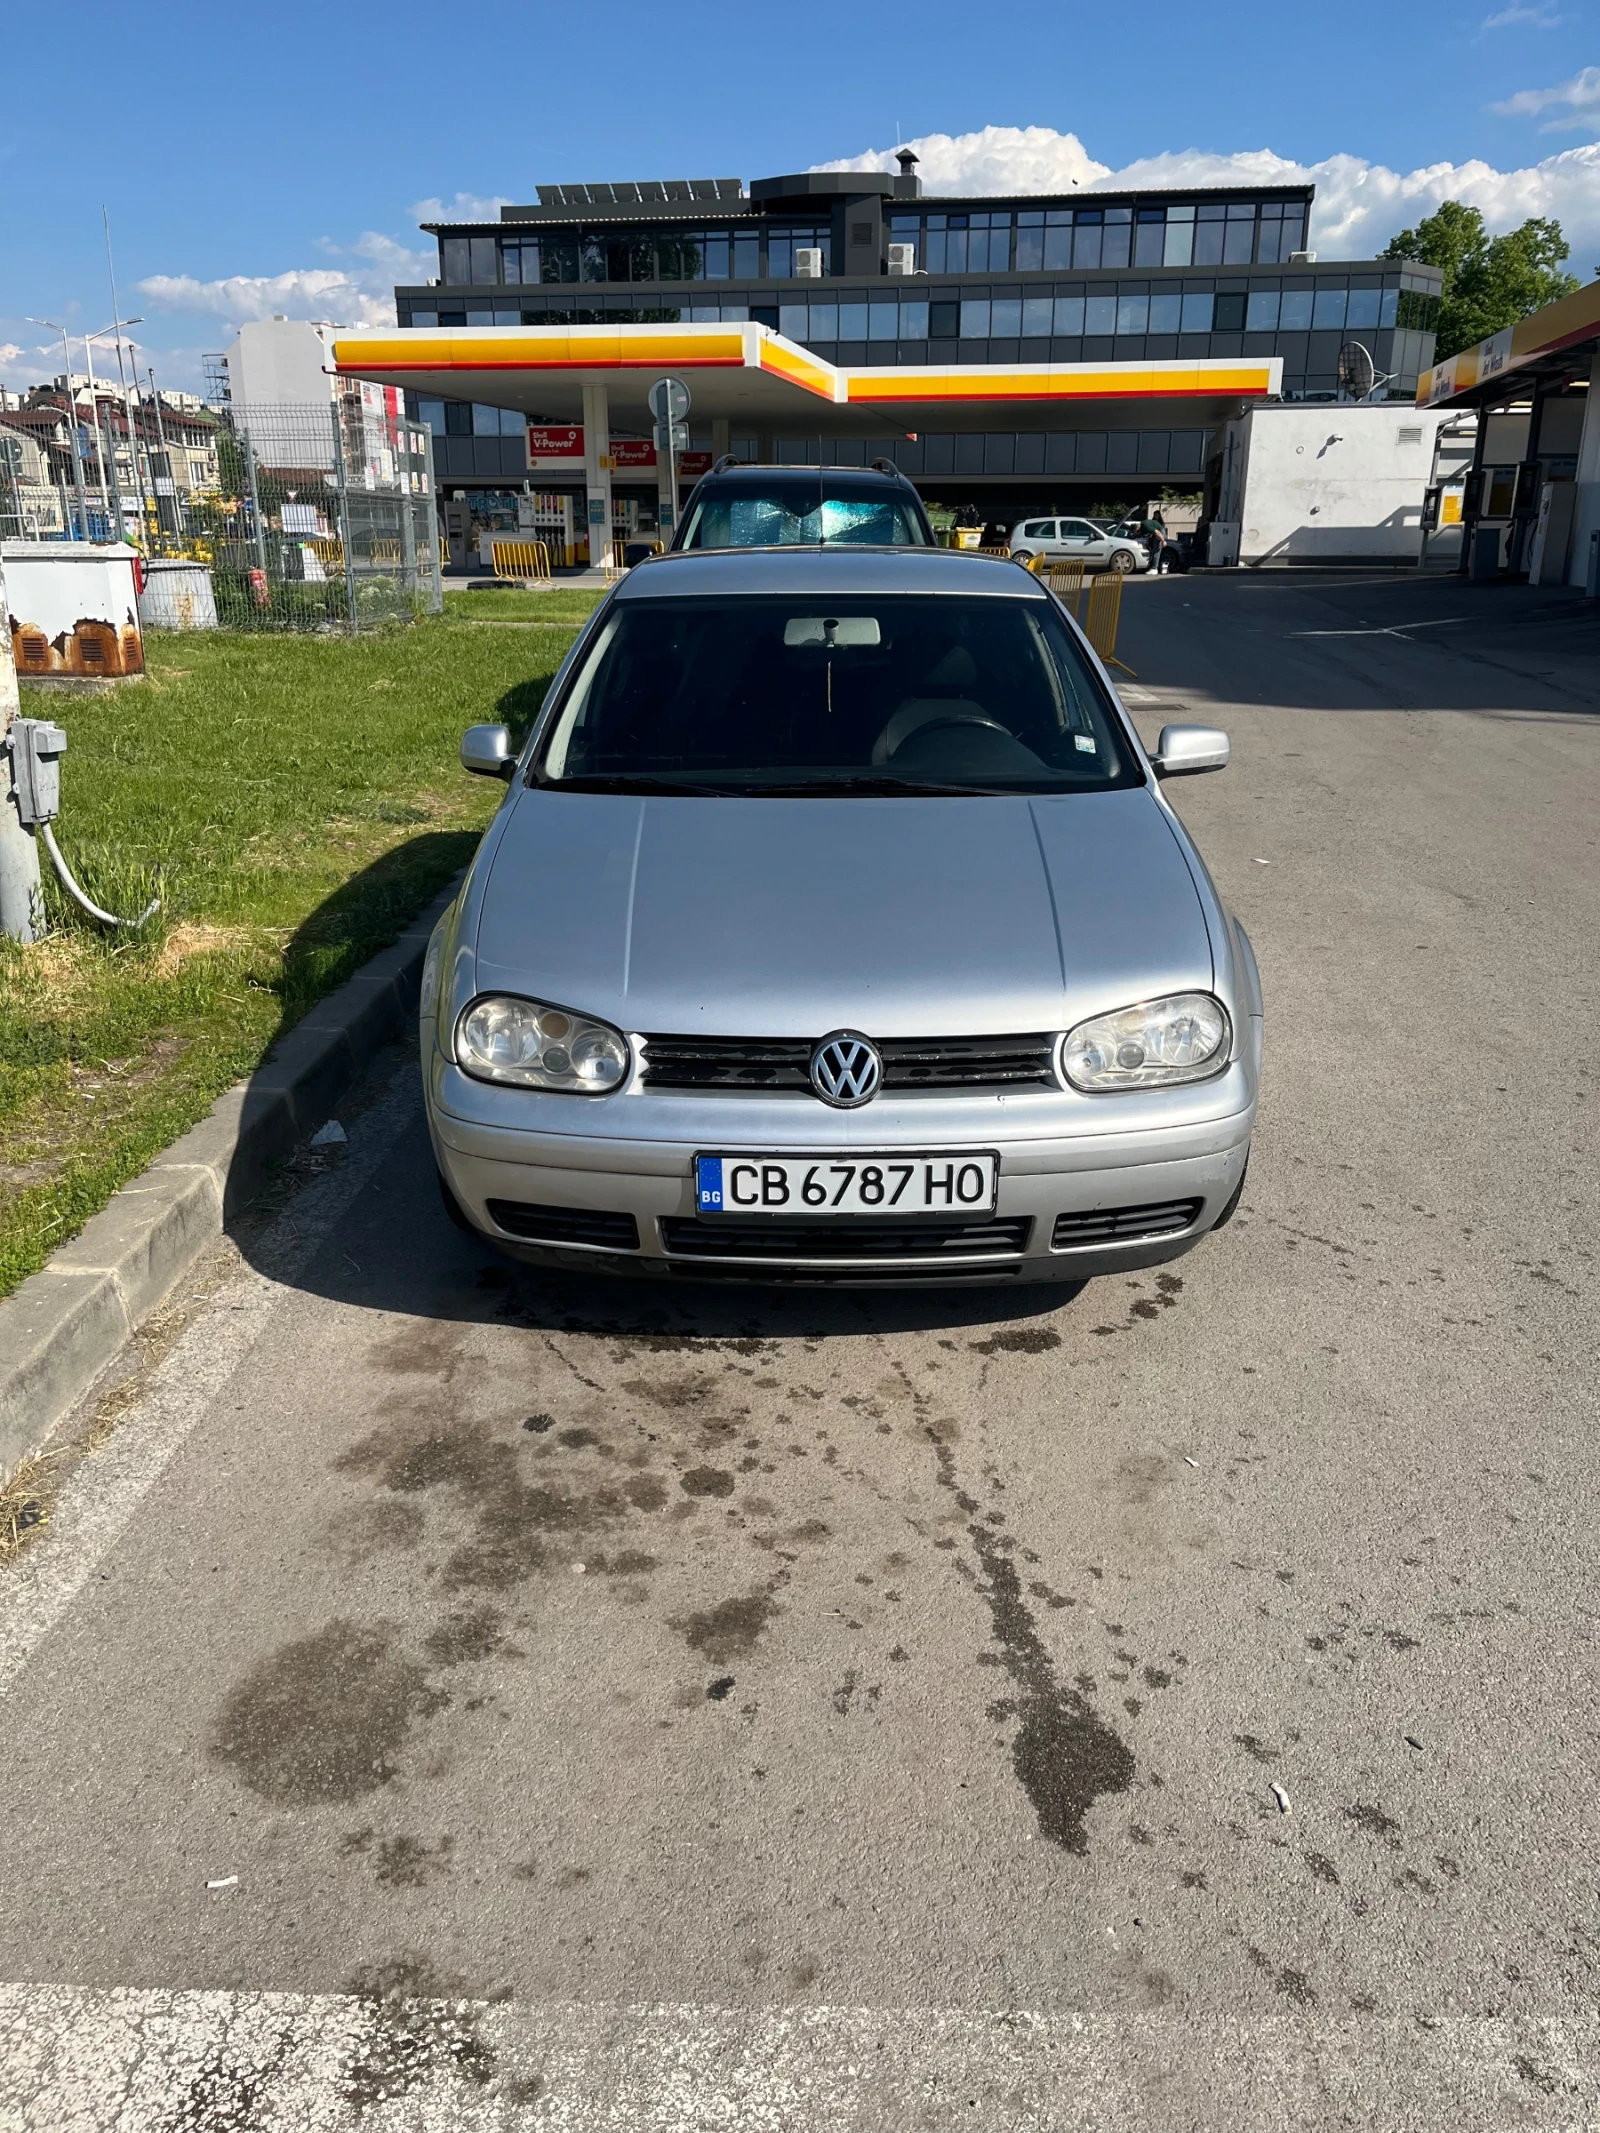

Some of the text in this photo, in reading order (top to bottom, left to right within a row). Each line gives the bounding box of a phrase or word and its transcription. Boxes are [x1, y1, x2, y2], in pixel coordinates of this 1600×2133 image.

[532, 431, 548, 439] Shell
[731, 1163, 984, 1206] CB 6787 HO
[701, 1191, 721, 1203] BG
